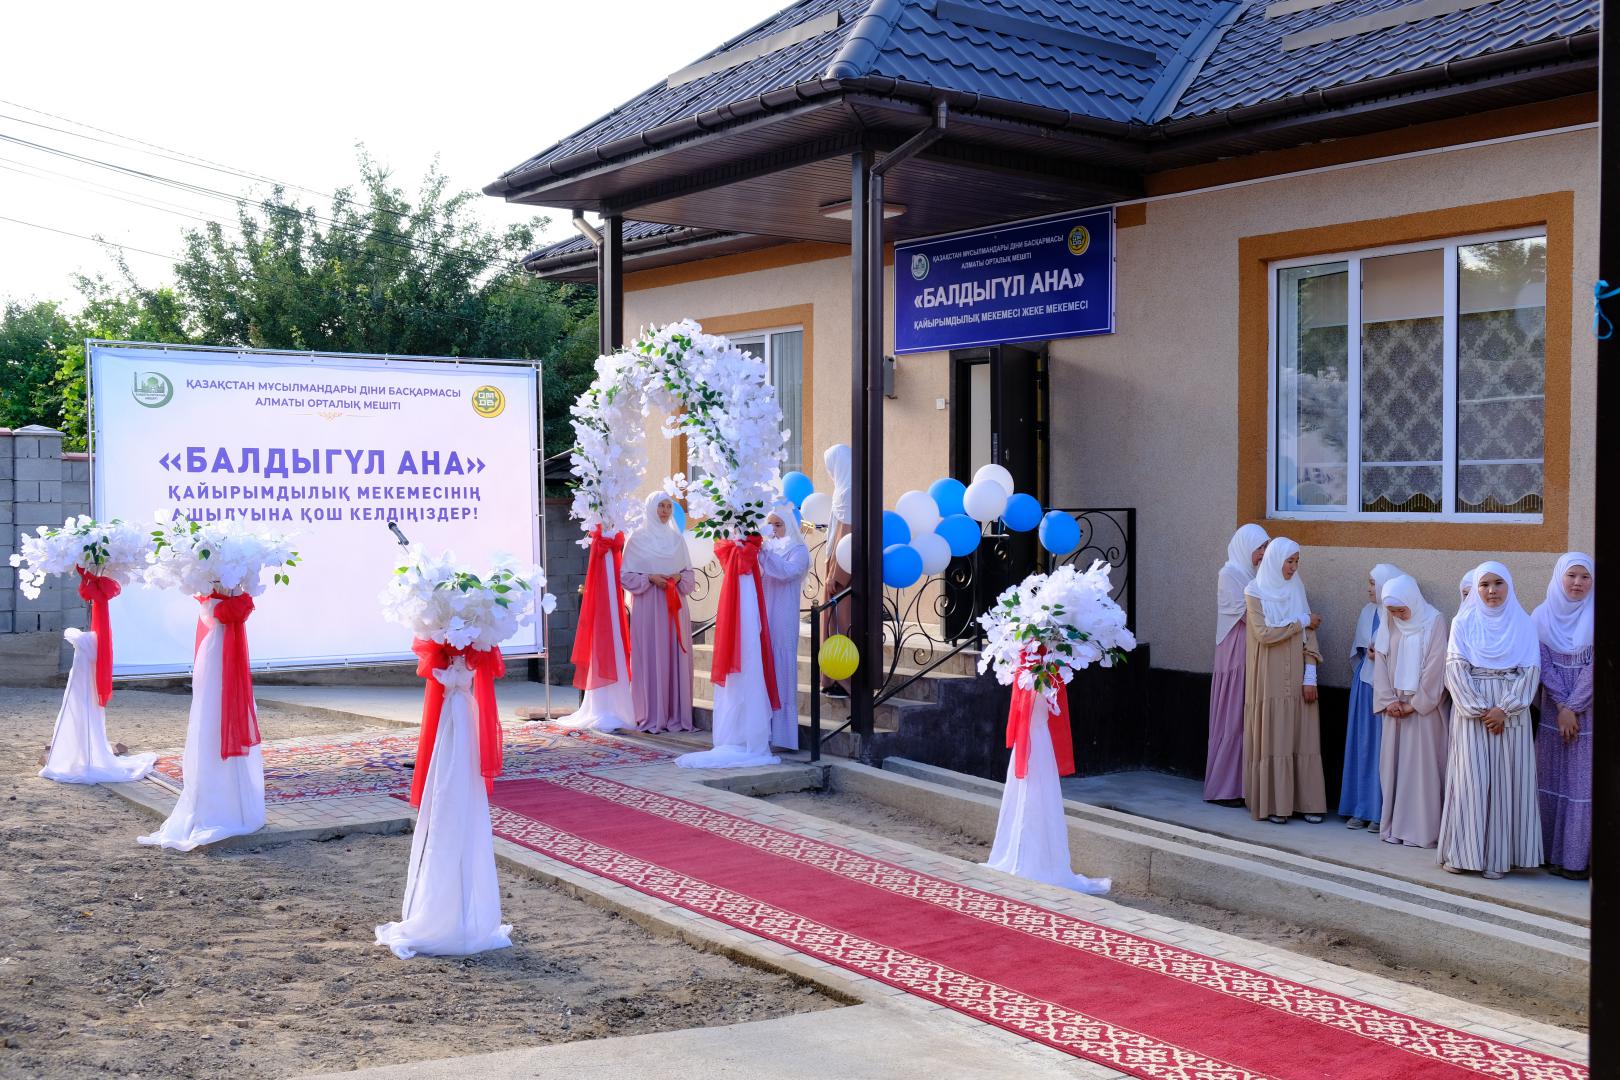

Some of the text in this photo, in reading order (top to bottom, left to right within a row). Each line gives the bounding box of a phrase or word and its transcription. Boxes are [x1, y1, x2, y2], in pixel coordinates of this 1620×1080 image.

[933, 250, 962, 263] ҚАЗАҚСТАН
[1024, 235, 1064, 248] БАСҚАРМАСЫ
[961, 252, 1032, 269] АЛМАТЫ ОРТАЛЫҚ МЕШІТІ
[914, 268, 1085, 309] «БАЛДЫГҮЛ АНА»
[914, 300, 1088, 330] ҚАЙЫРЫМДЫЛЫҚ МЕКЕМЕСІ ЖЕКЕ МЕКЕМЕСІ
[186, 379, 461, 398] ҚАЗАҚСТАН МҰСЫЛМАНДАРЫ ДІНИ БАСҚАРМАСЫ
[255, 397, 401, 411] АЛМАТЫ ОРТАЛЫҚ МЕШІТІ
[158, 446, 486, 479] «БАЛДЫГҮЛ АНА»
[168, 482, 481, 502] ҚАЙЫРЫМДЫЛЫҚ МЕКЕМЕСІНІҢ
[300, 507, 342, 523] ҚОШ
[350, 506, 479, 523] КЕЛДІҢІЗДЕР!
